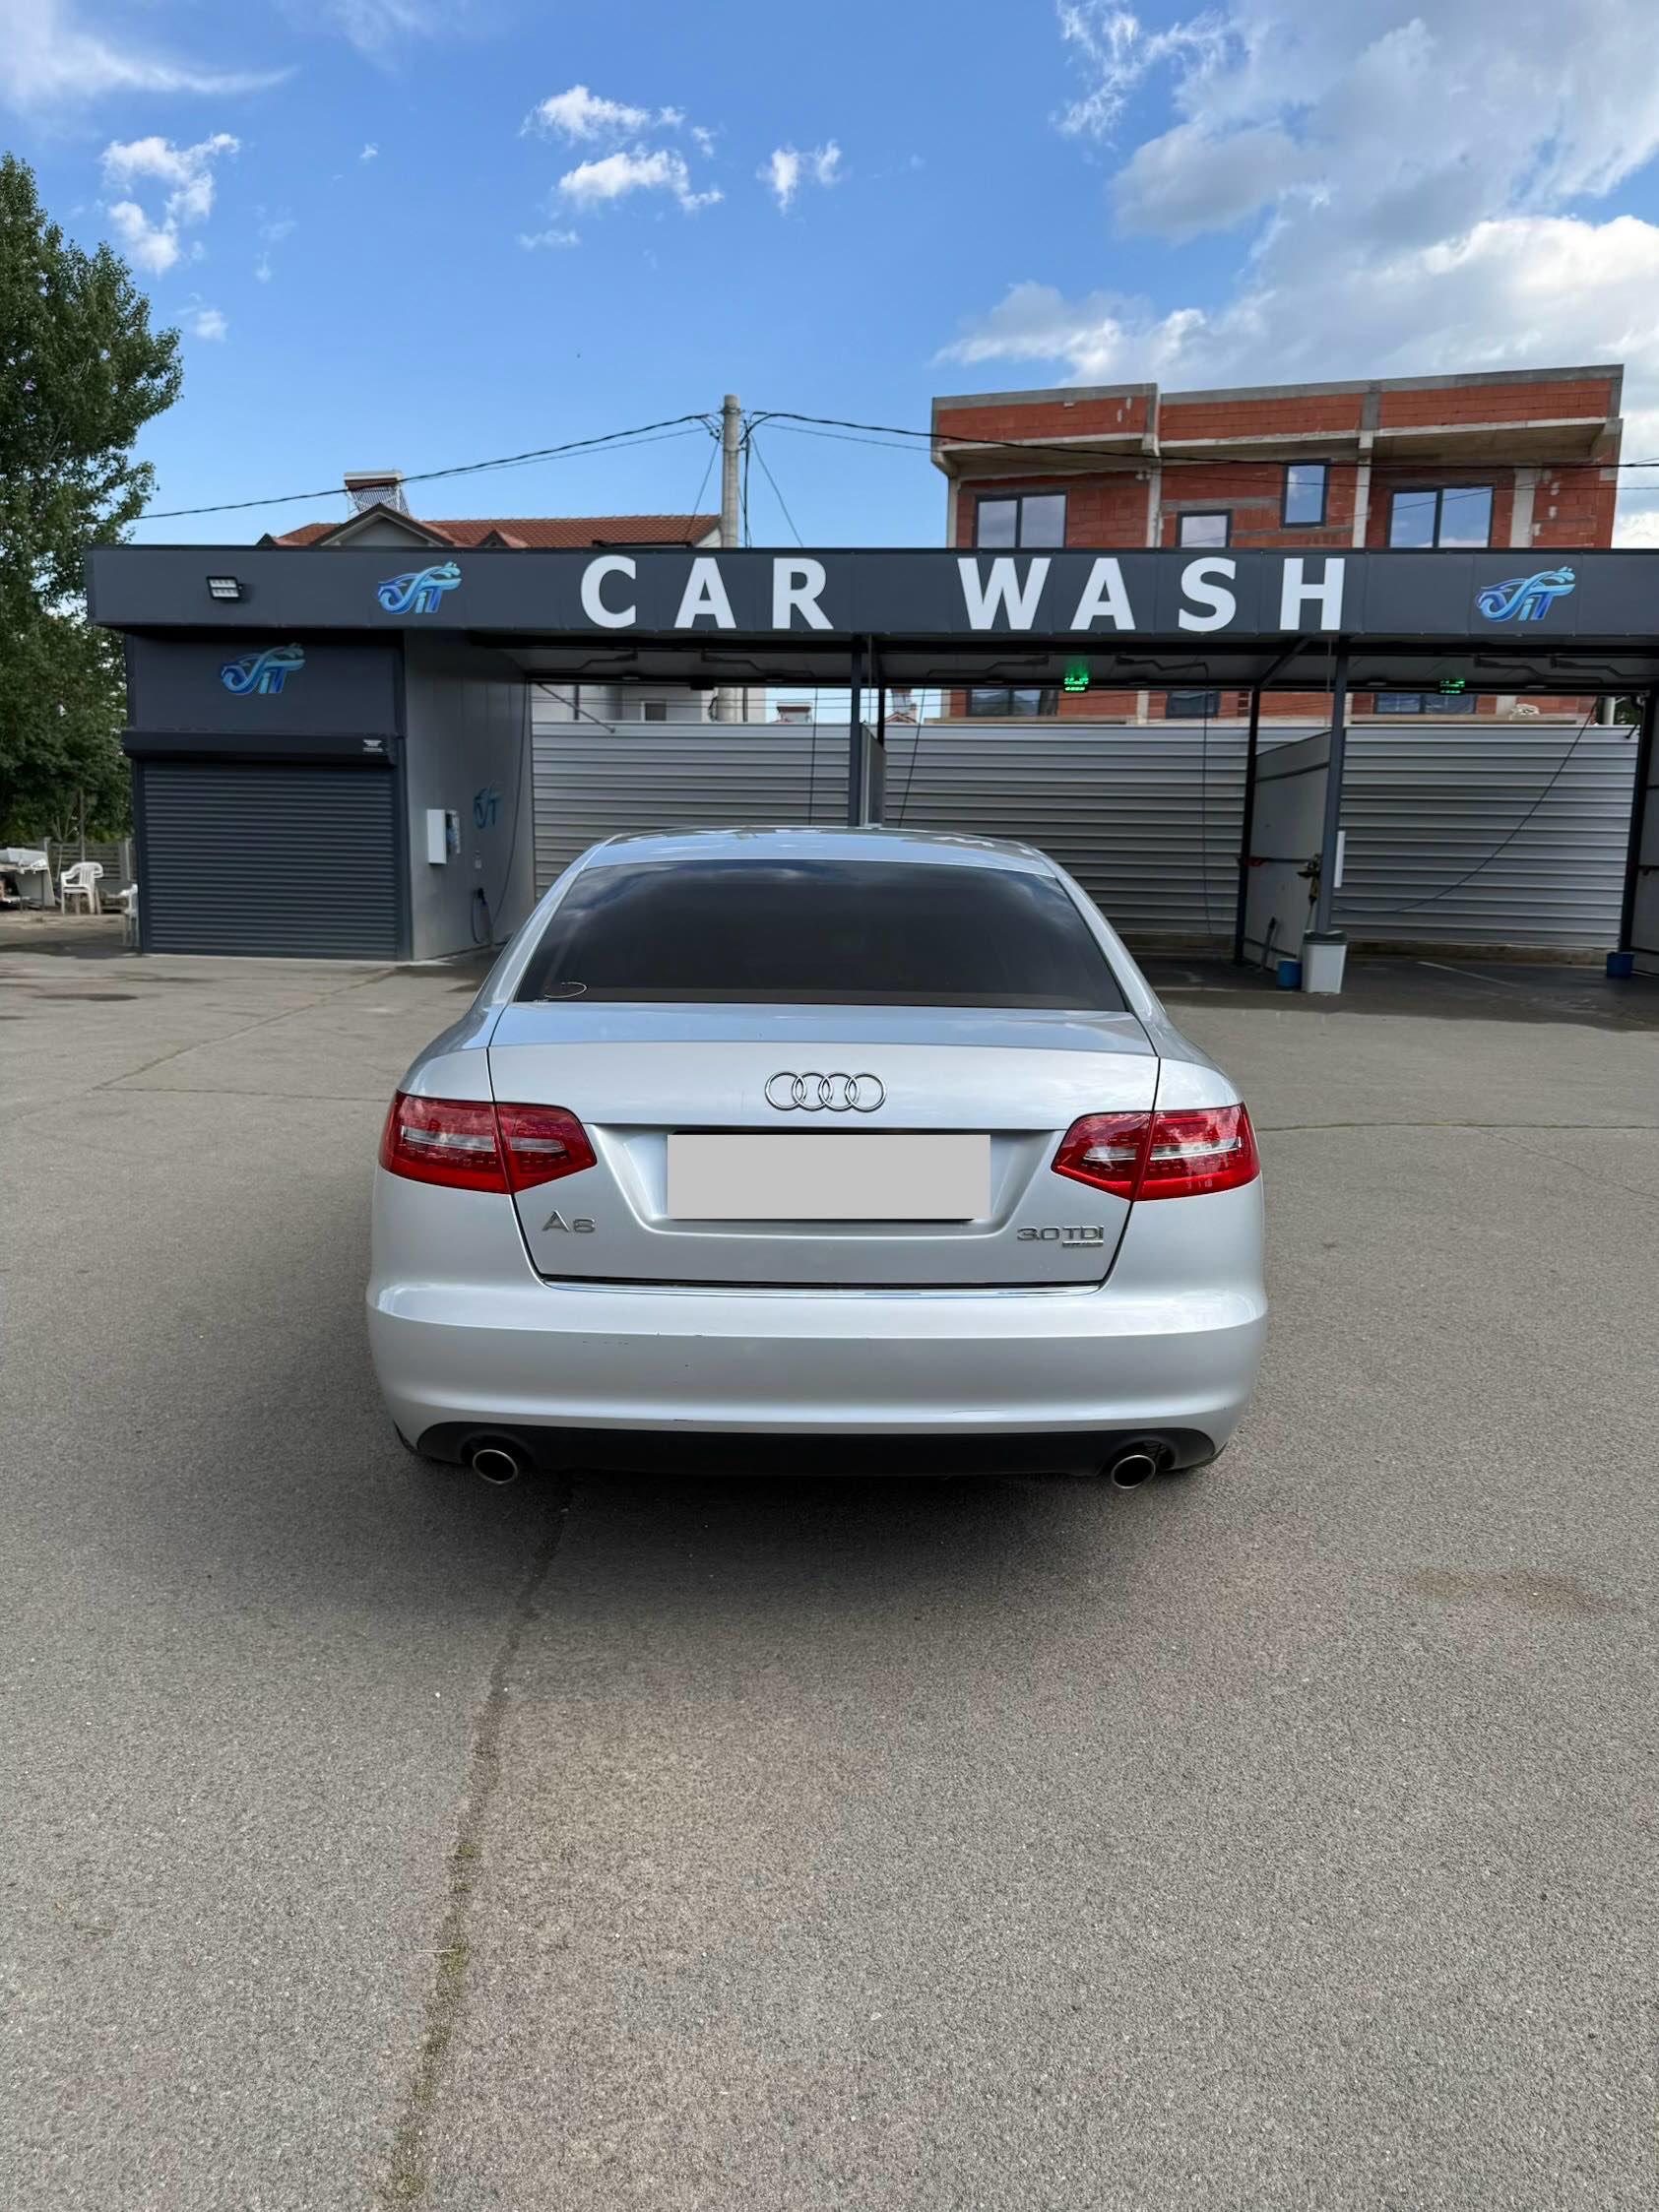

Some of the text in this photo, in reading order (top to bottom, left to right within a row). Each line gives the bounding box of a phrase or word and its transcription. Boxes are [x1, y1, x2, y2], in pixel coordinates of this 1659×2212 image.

[580, 554, 1346, 632] CAR WASH
[542, 1210, 596, 1233] A6
